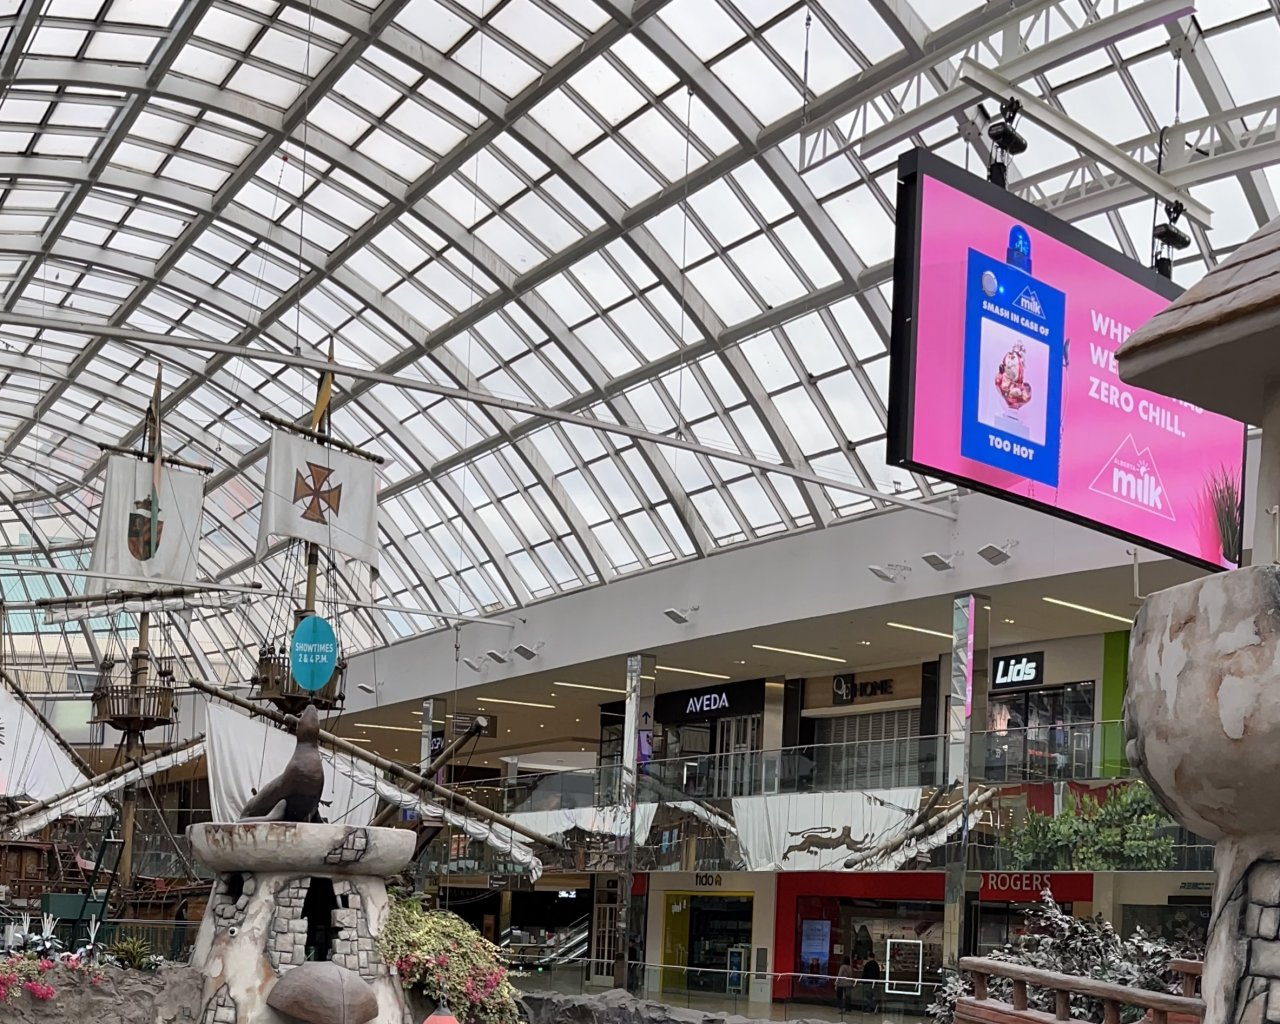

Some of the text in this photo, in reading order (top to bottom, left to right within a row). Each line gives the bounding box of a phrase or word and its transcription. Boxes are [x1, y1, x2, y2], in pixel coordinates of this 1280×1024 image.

[1020, 296, 1041, 315] milk
[982, 300, 1050, 337] SMASH IN CASE OF
[1091, 309, 1135, 344] WHE
[1088, 376, 1134, 414] ZERO
[1138, 399, 1186, 438] CHILL.
[988, 434, 1035, 461] TOO HOT
[1113, 467, 1162, 510] milk
[295, 642, 334, 653] SHOWTIMES
[298, 654, 329, 664] 2 & 4 P.M.
[995, 656, 1037, 684] Lids
[852, 678, 894, 698] HOME
[685, 690, 730, 714] AVEDA
[989, 873, 1052, 891] ROGERS
